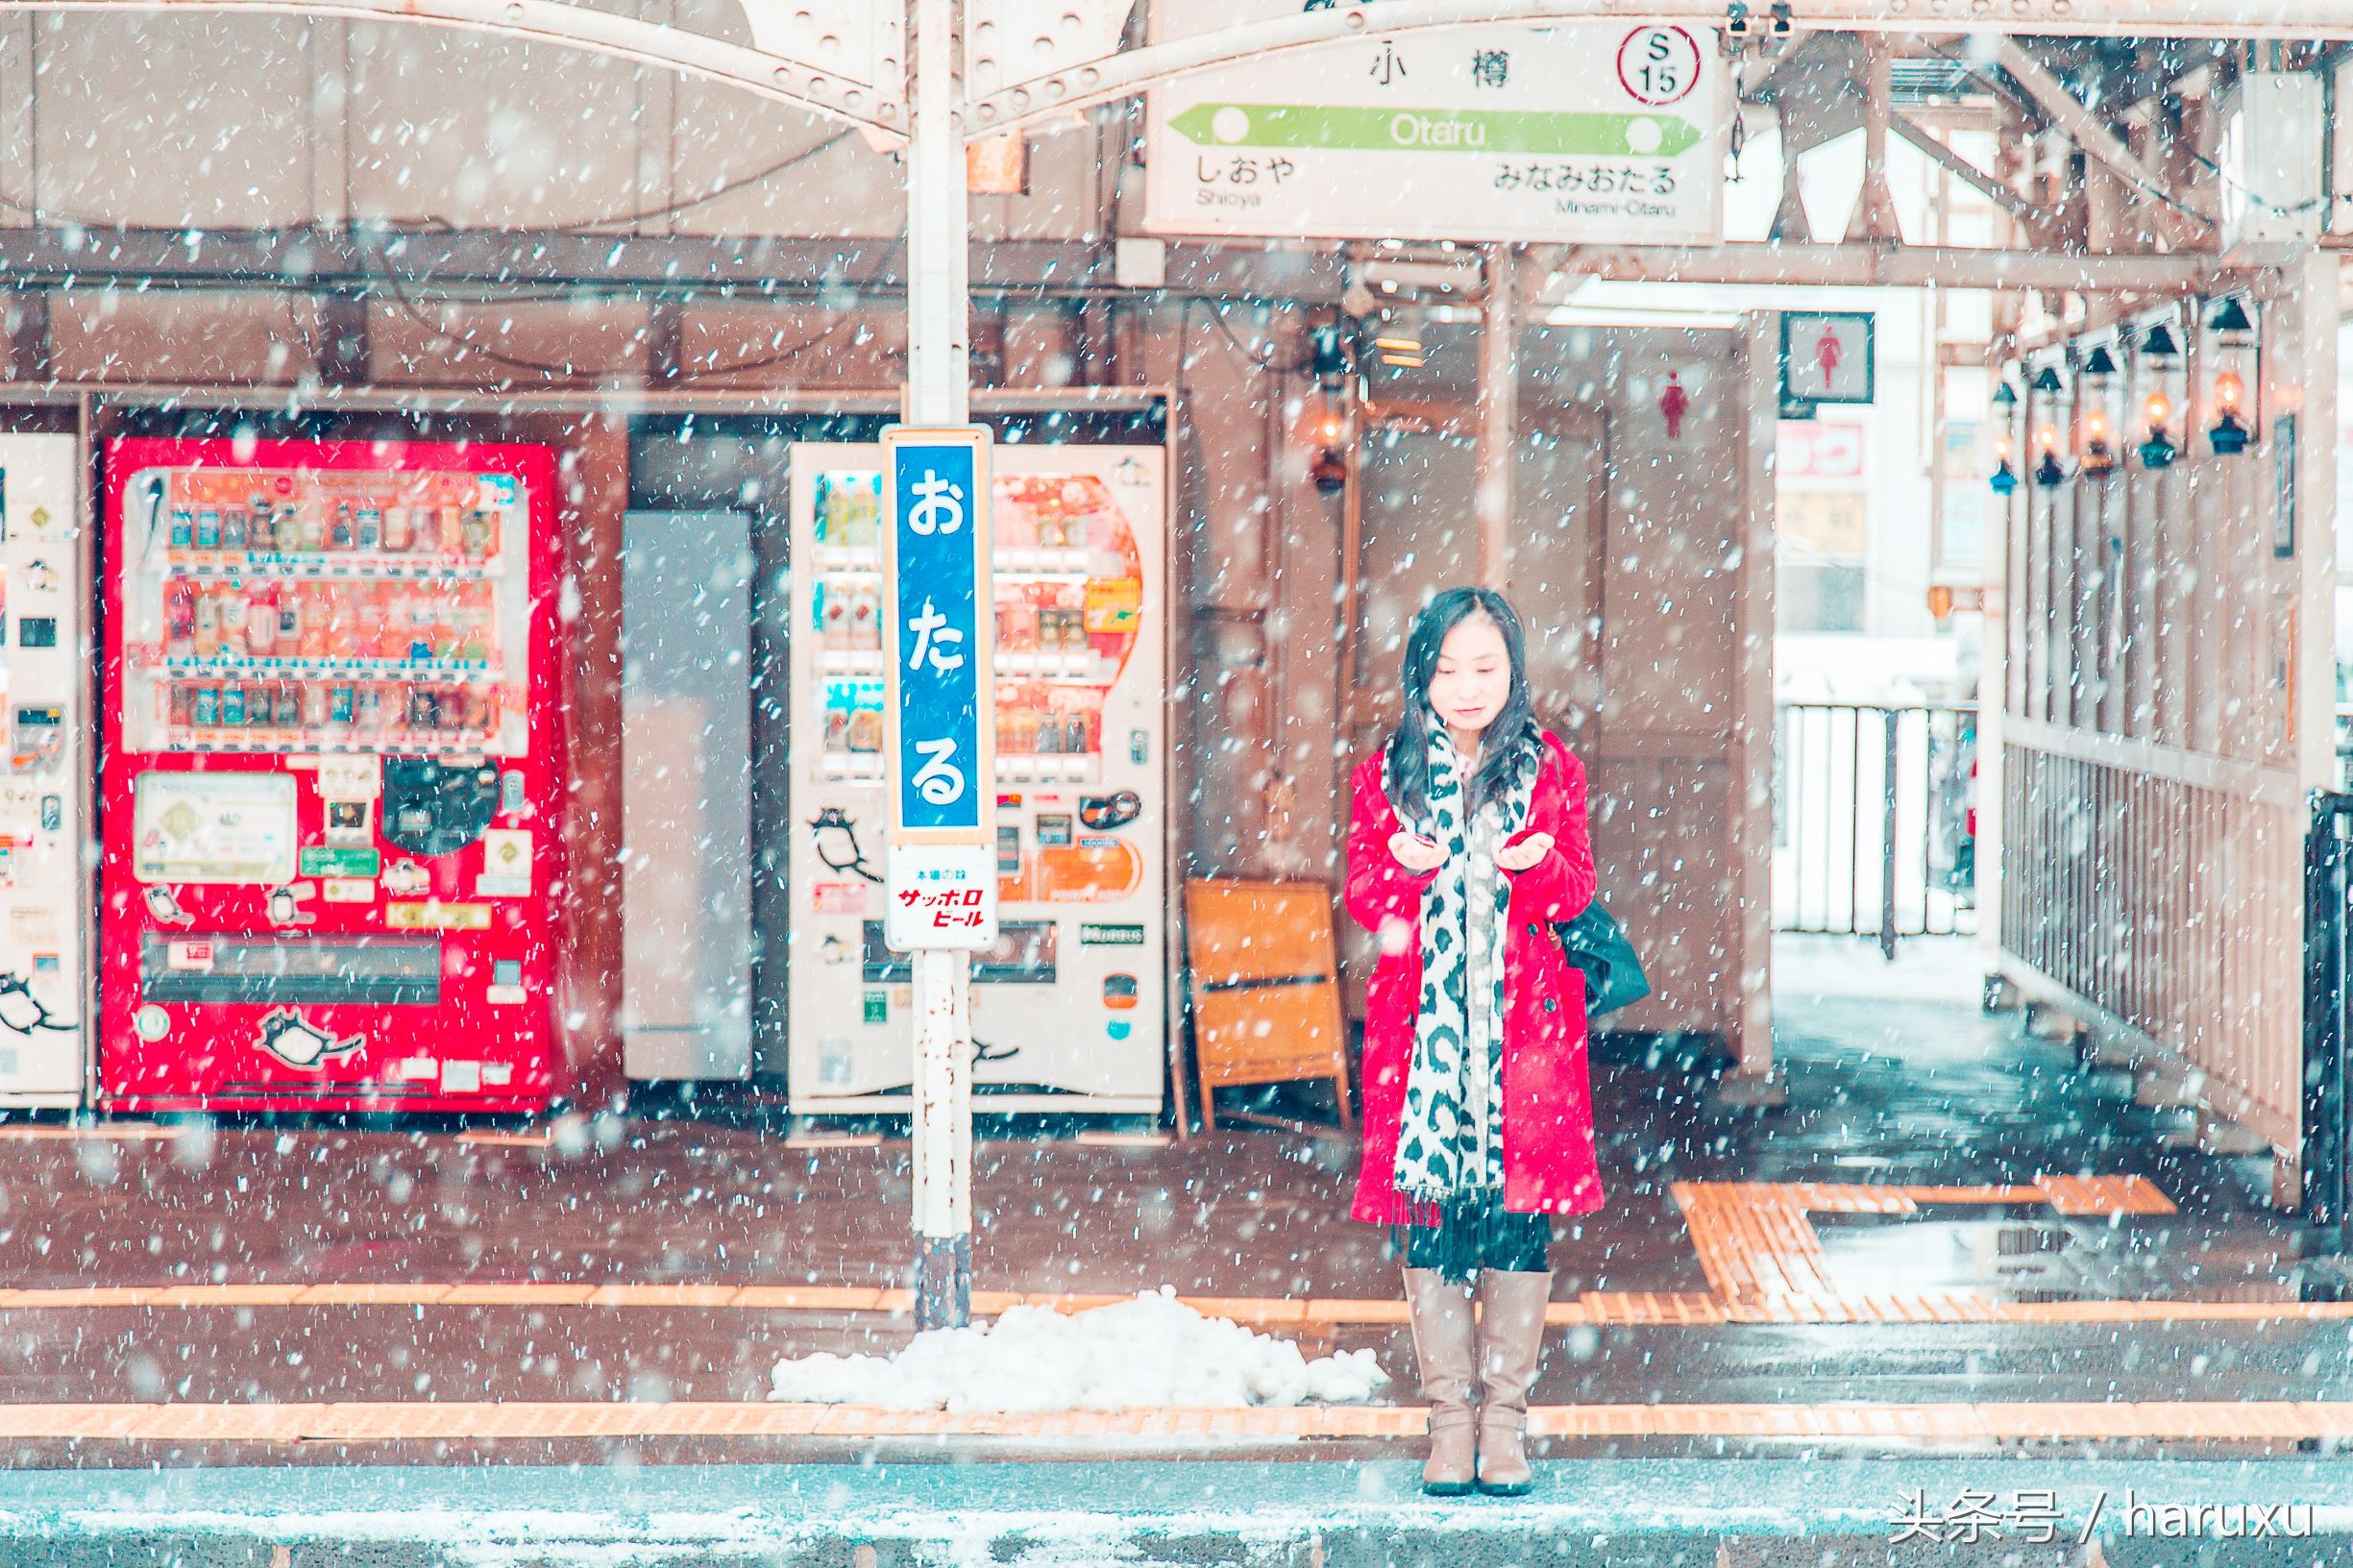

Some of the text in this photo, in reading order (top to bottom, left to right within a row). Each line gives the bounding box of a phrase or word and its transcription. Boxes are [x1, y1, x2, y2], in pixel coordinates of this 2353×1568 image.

[1648, 33, 1669, 61] S
[1369, 40, 1509, 87] 小樽
[1638, 65, 1676, 93] 15
[1390, 112, 1486, 146] Otaru
[1197, 155, 1294, 184] しおや
[1493, 163, 1677, 194] みなみおたる
[1196, 189, 1262, 209] Shioya
[1555, 198, 1677, 217] Minami-Otaru
[908, 468, 965, 805] おたる
[897, 889, 984, 907] サッポロ
[933, 910, 984, 928] ビール
